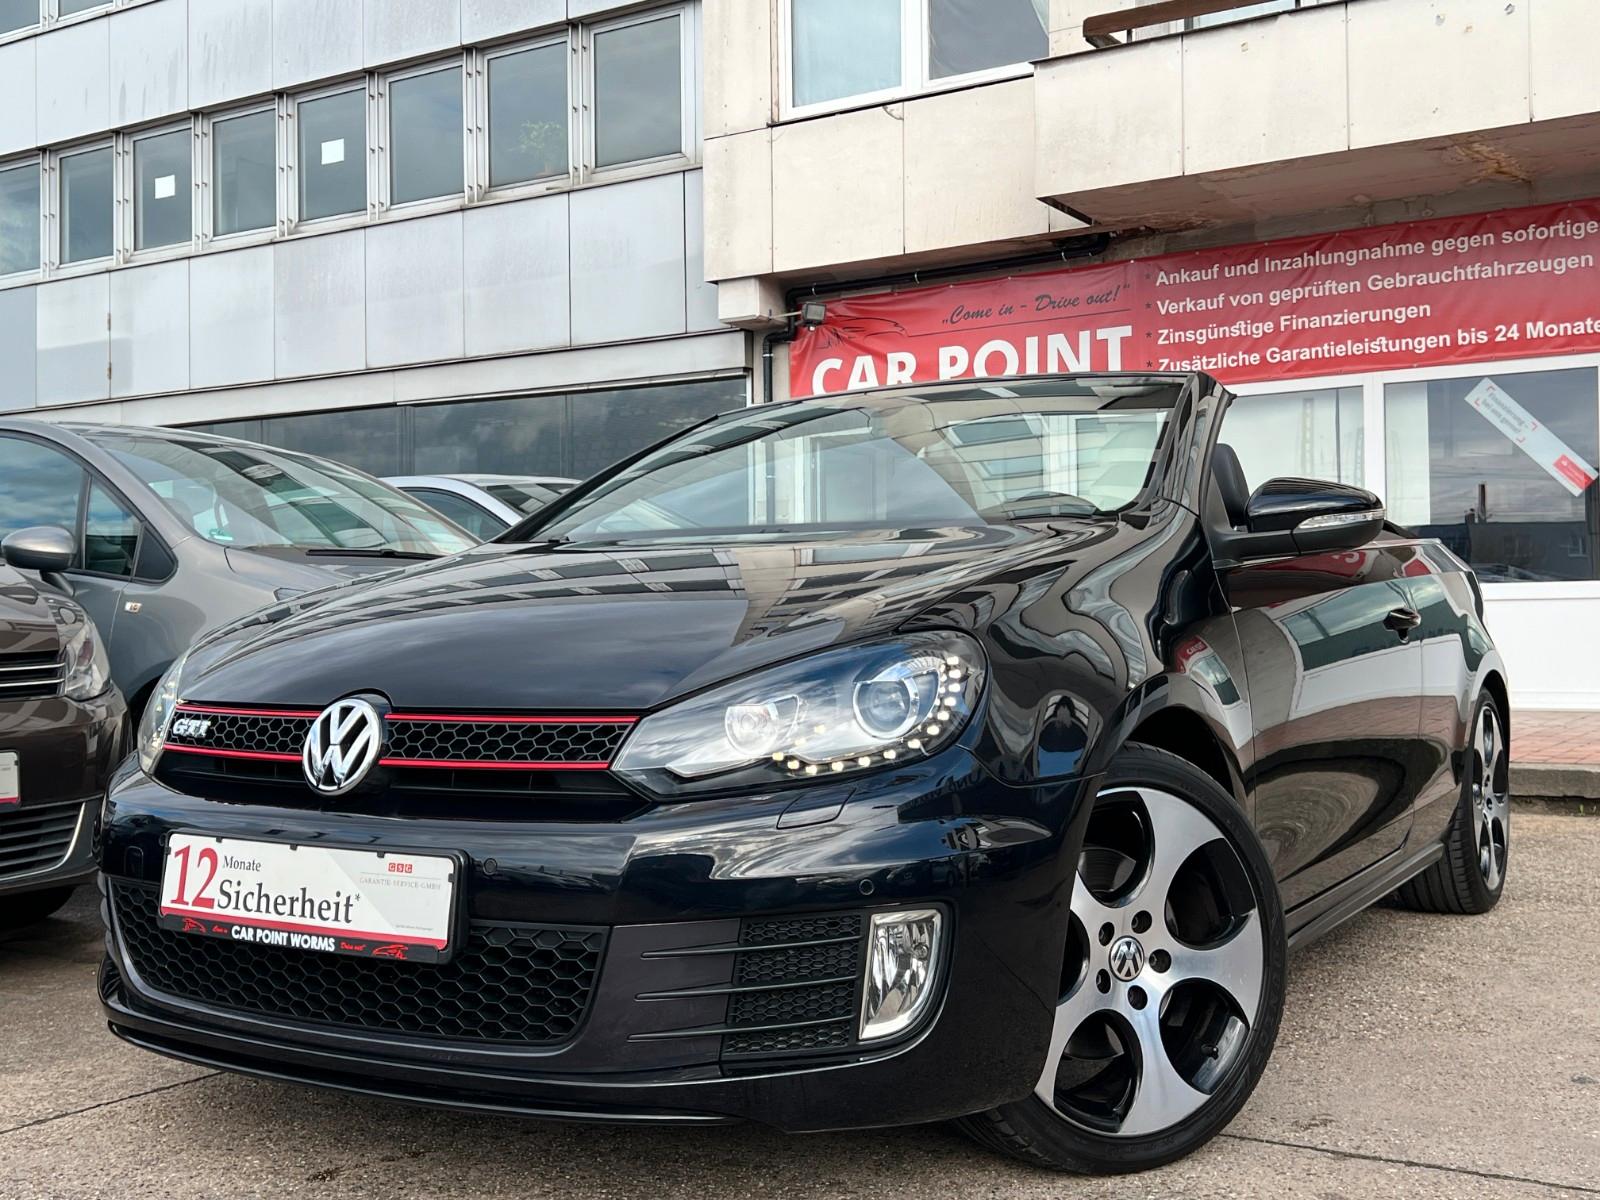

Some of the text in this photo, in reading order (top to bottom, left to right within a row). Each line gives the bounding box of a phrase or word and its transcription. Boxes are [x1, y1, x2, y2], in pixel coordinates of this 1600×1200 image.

[1156, 264, 1219, 286] Ankauf
[1225, 259, 1259, 277] und
[1265, 242, 1425, 272] Inzahlungnahme
[1431, 233, 1494, 256] gegen
[998, 304, 1014, 315] in
[1035, 294, 1080, 311] Drive
[1157, 254, 1593, 315] Verkauf von geprüften Gebrauchtfahrzeugen
[1157, 303, 1431, 345] Zinsgünstige Finanzierungen
[812, 325, 1132, 396] CAR POINT
[1158, 350, 1260, 372] Zusätzliche
[1266, 333, 1451, 363] Garantieleistungen
[1457, 328, 1489, 346] bis
[1494, 323, 1520, 342] 24
[173, 717, 211, 738] GTI
[169, 844, 219, 909] 12
[222, 855, 262, 872] Monate
[231, 925, 254, 941] CAR
[256, 930, 288, 946] POINT
[290, 935, 335, 951] WORMS
